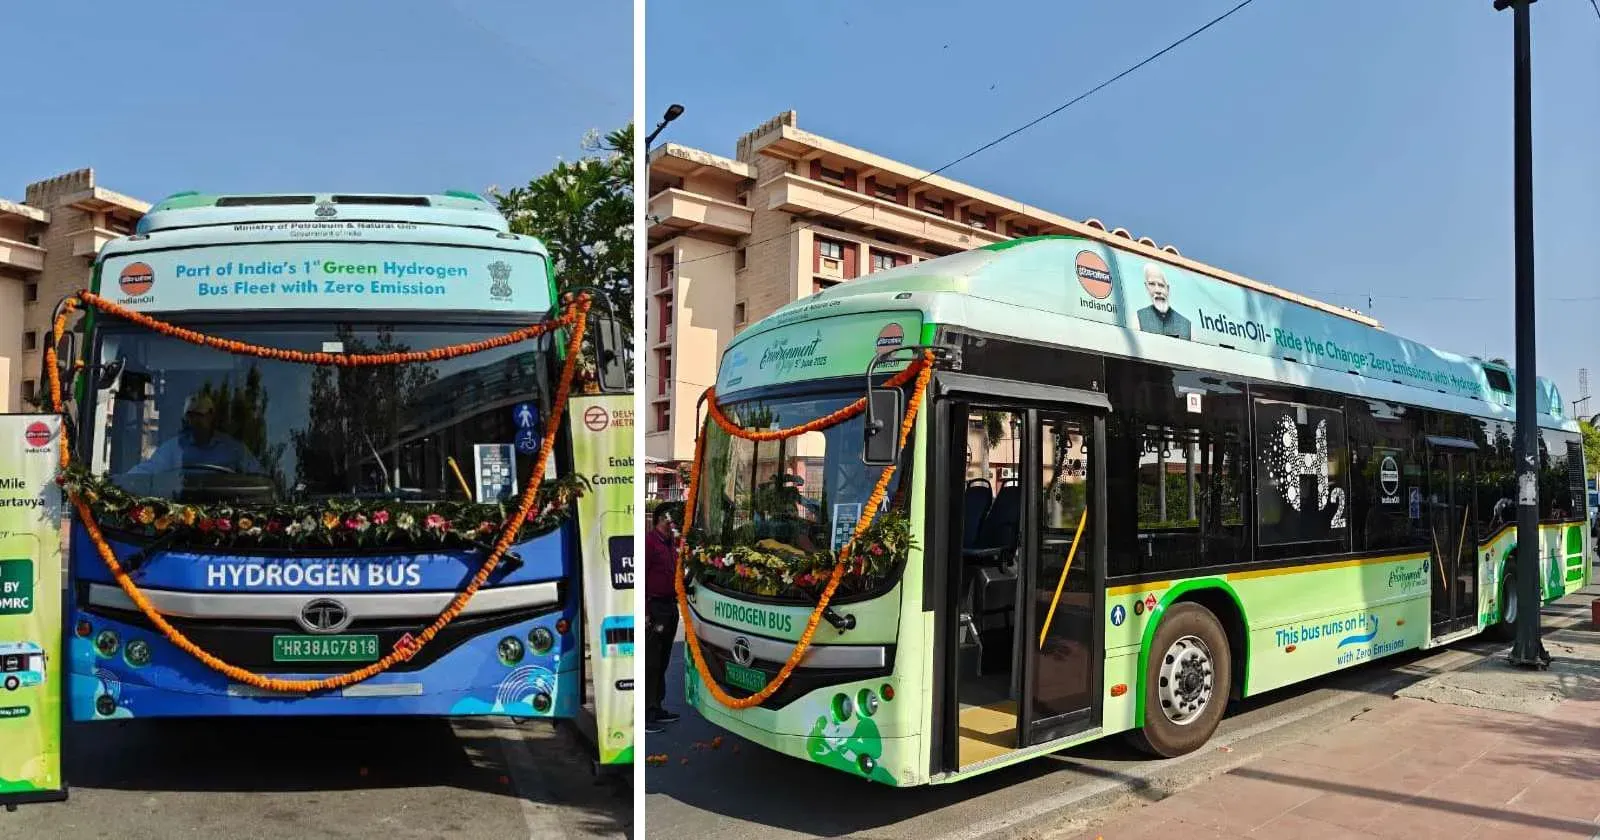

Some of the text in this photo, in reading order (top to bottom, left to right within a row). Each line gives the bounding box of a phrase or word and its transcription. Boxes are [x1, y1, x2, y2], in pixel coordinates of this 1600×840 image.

[175, 264, 210, 278] Part
[215, 262, 233, 277] of
[238, 260, 297, 276] India's
[323, 261, 377, 275] Green
[383, 261, 469, 280] Hydrogen
[197, 279, 446, 297] Bus Fleet with Zero Emission
[1079, 296, 1118, 316] IndianOil
[1198, 308, 1272, 343] IndianOil-
[1273, 327, 1302, 351] Ride
[1303, 335, 1325, 357] the
[1369, 352, 1392, 373] Zero
[1392, 358, 1433, 382] Emissions
[1432, 370, 1448, 386] with
[608, 456, 634, 467] Enab
[0, 477, 26, 490] Mile
[591, 474, 634, 485] Connec
[206, 563, 421, 587] HYDROGEN BUS
[3, 581, 20, 593] BY
[0, 596, 29, 609] MRC
[713, 600, 792, 633] HYDROGEN BUS
[1275, 627, 1299, 648] This
[1301, 624, 1320, 642] bus
[1321, 620, 1343, 637] runs
[1344, 617, 1357, 632] on
[1336, 638, 1404, 666] with Zero Emissions
